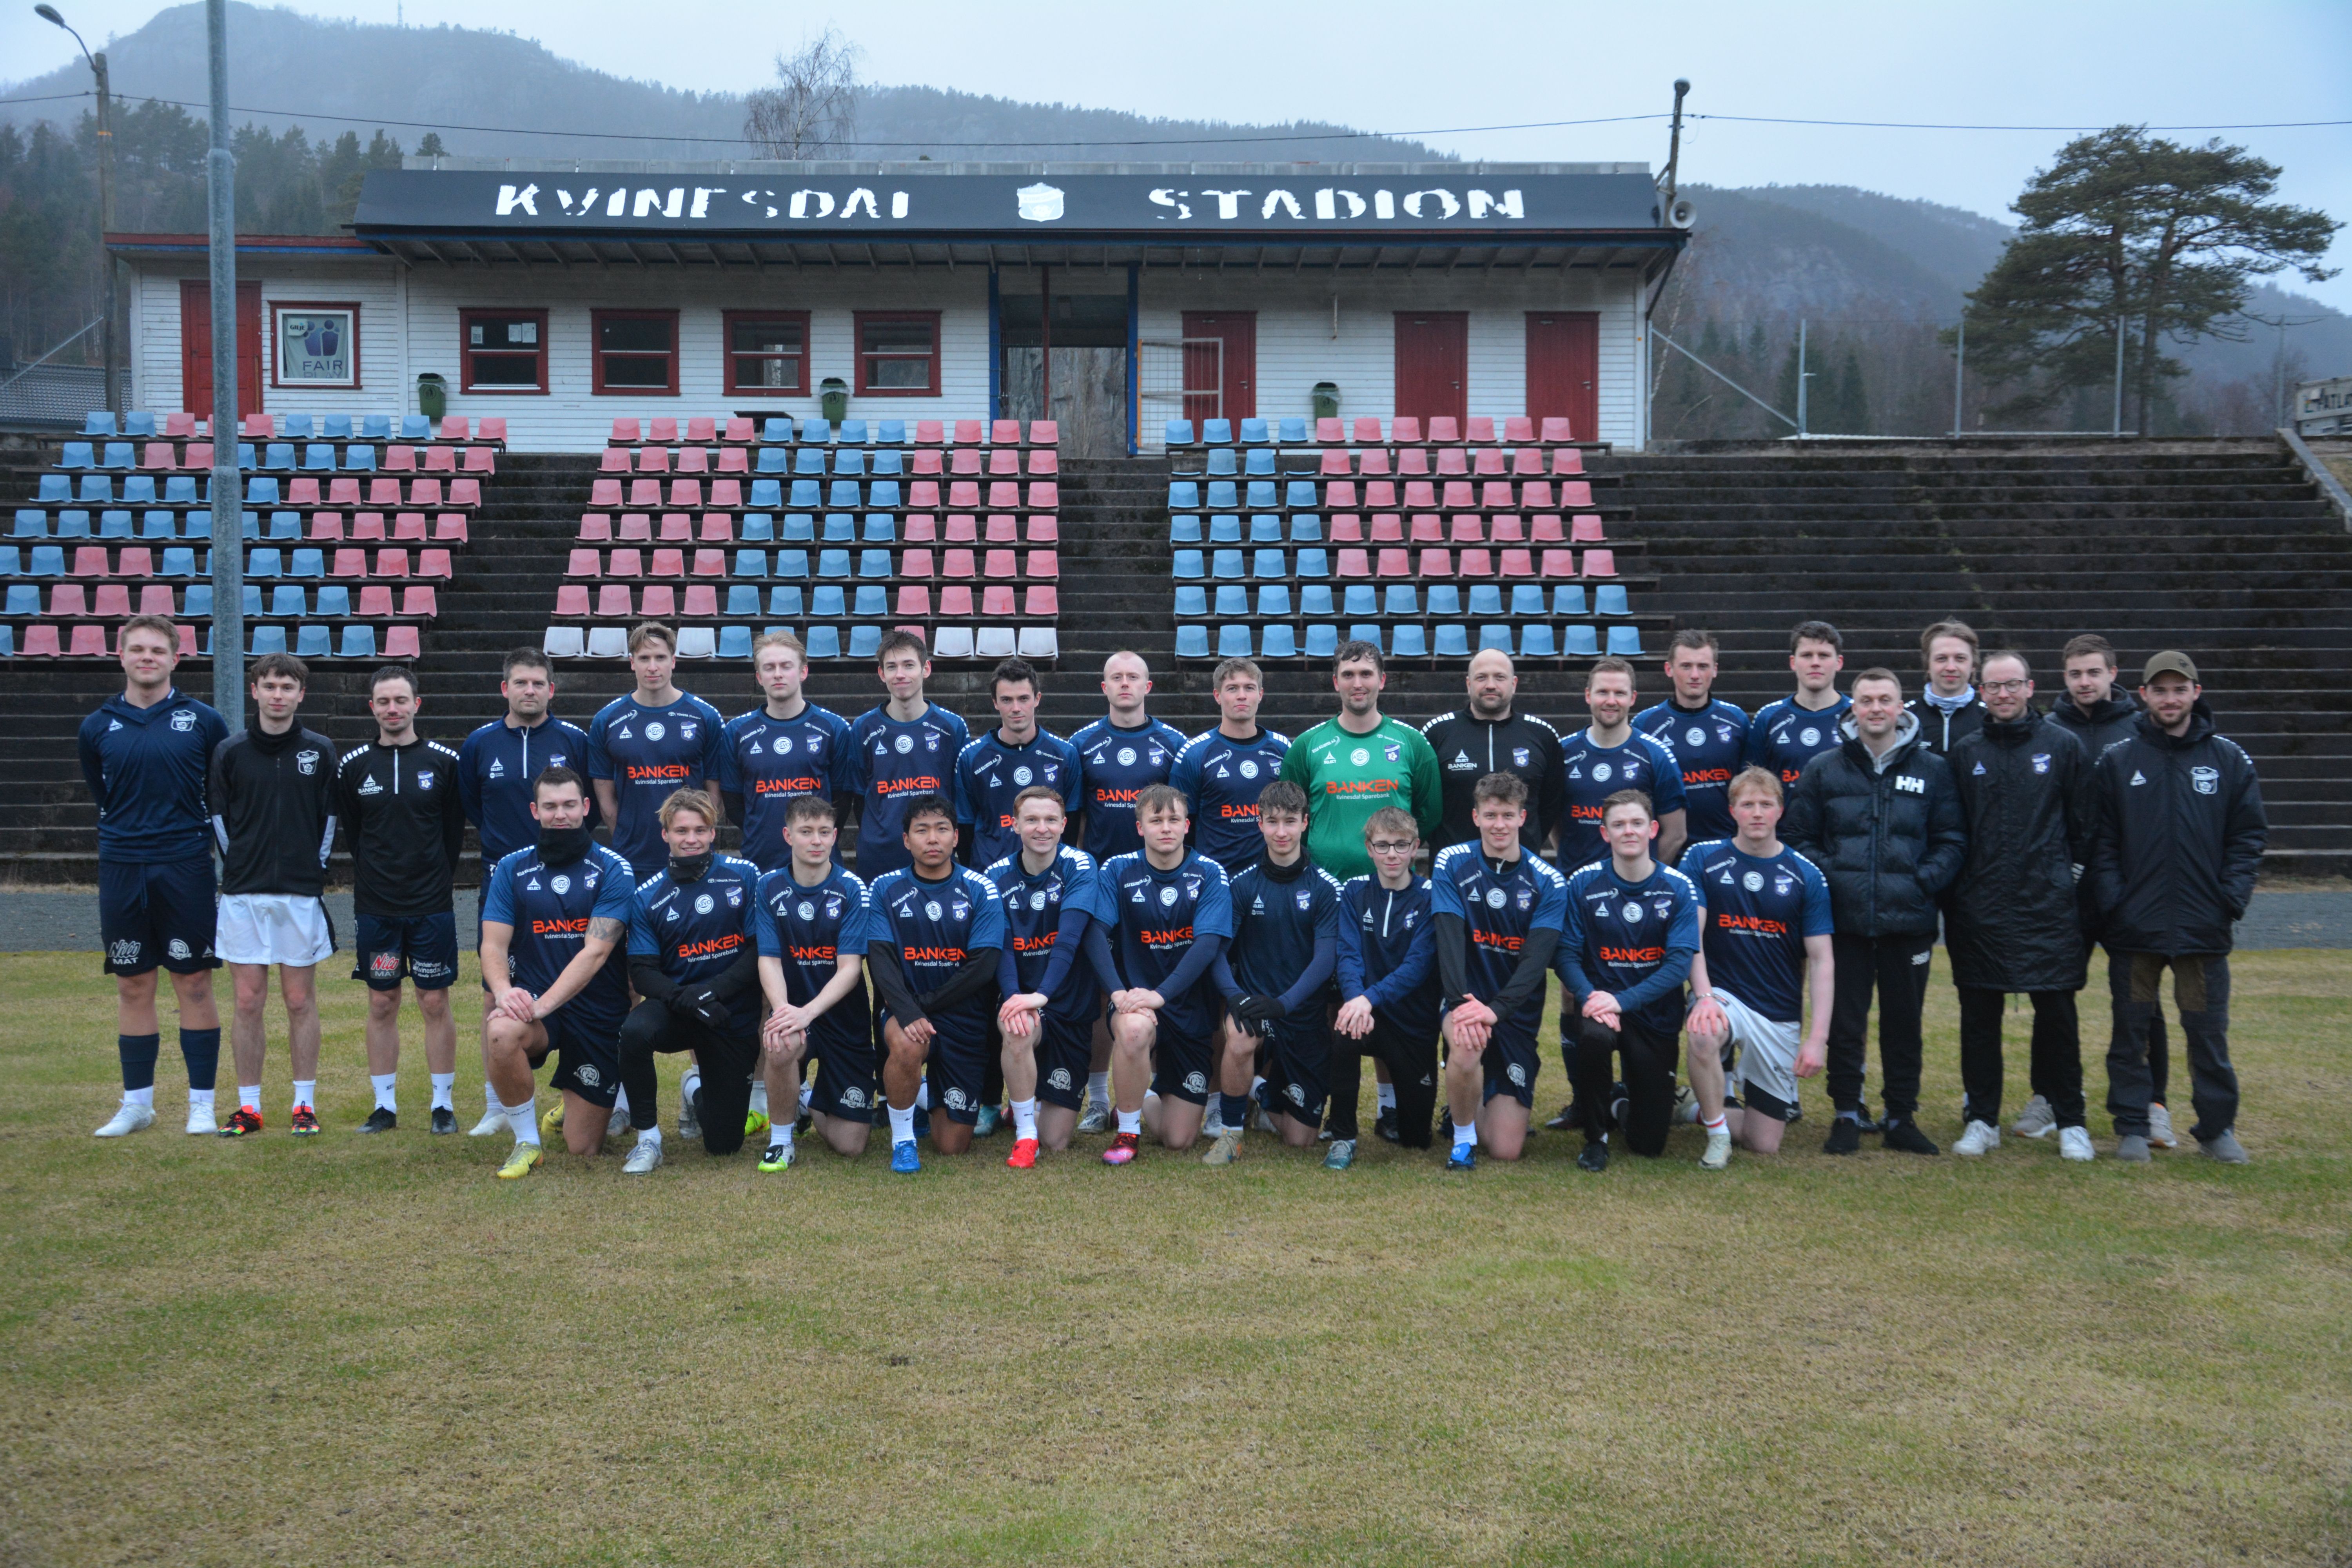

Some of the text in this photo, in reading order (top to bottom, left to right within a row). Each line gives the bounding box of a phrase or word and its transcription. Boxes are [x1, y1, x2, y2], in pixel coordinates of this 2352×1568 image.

[1149, 188, 1525, 220] STADION
[303, 360, 342, 370] FAIR
[627, 765, 689, 779] BANKEN
[358, 786, 383, 794] BANKEN
[756, 777, 821, 793] BANKEN
[877, 776, 940, 794] BANKEN
[1327, 779, 1398, 794] BANKEN
[1895, 775, 1925, 794] HH
[1097, 789, 1143, 802] BANK
[697, 899, 711, 908] ASVO
[532, 918, 590, 933] BANKE
[1719, 914, 1786, 934] BANKEN
[1141, 926, 1193, 943] BANKE
[678, 932, 744, 957] BANKEN
[370, 953, 399, 971] Nico
[687, 947, 738, 963] Kvinesdal Sparebank
[416, 965, 441, 974] Kvinesdal
